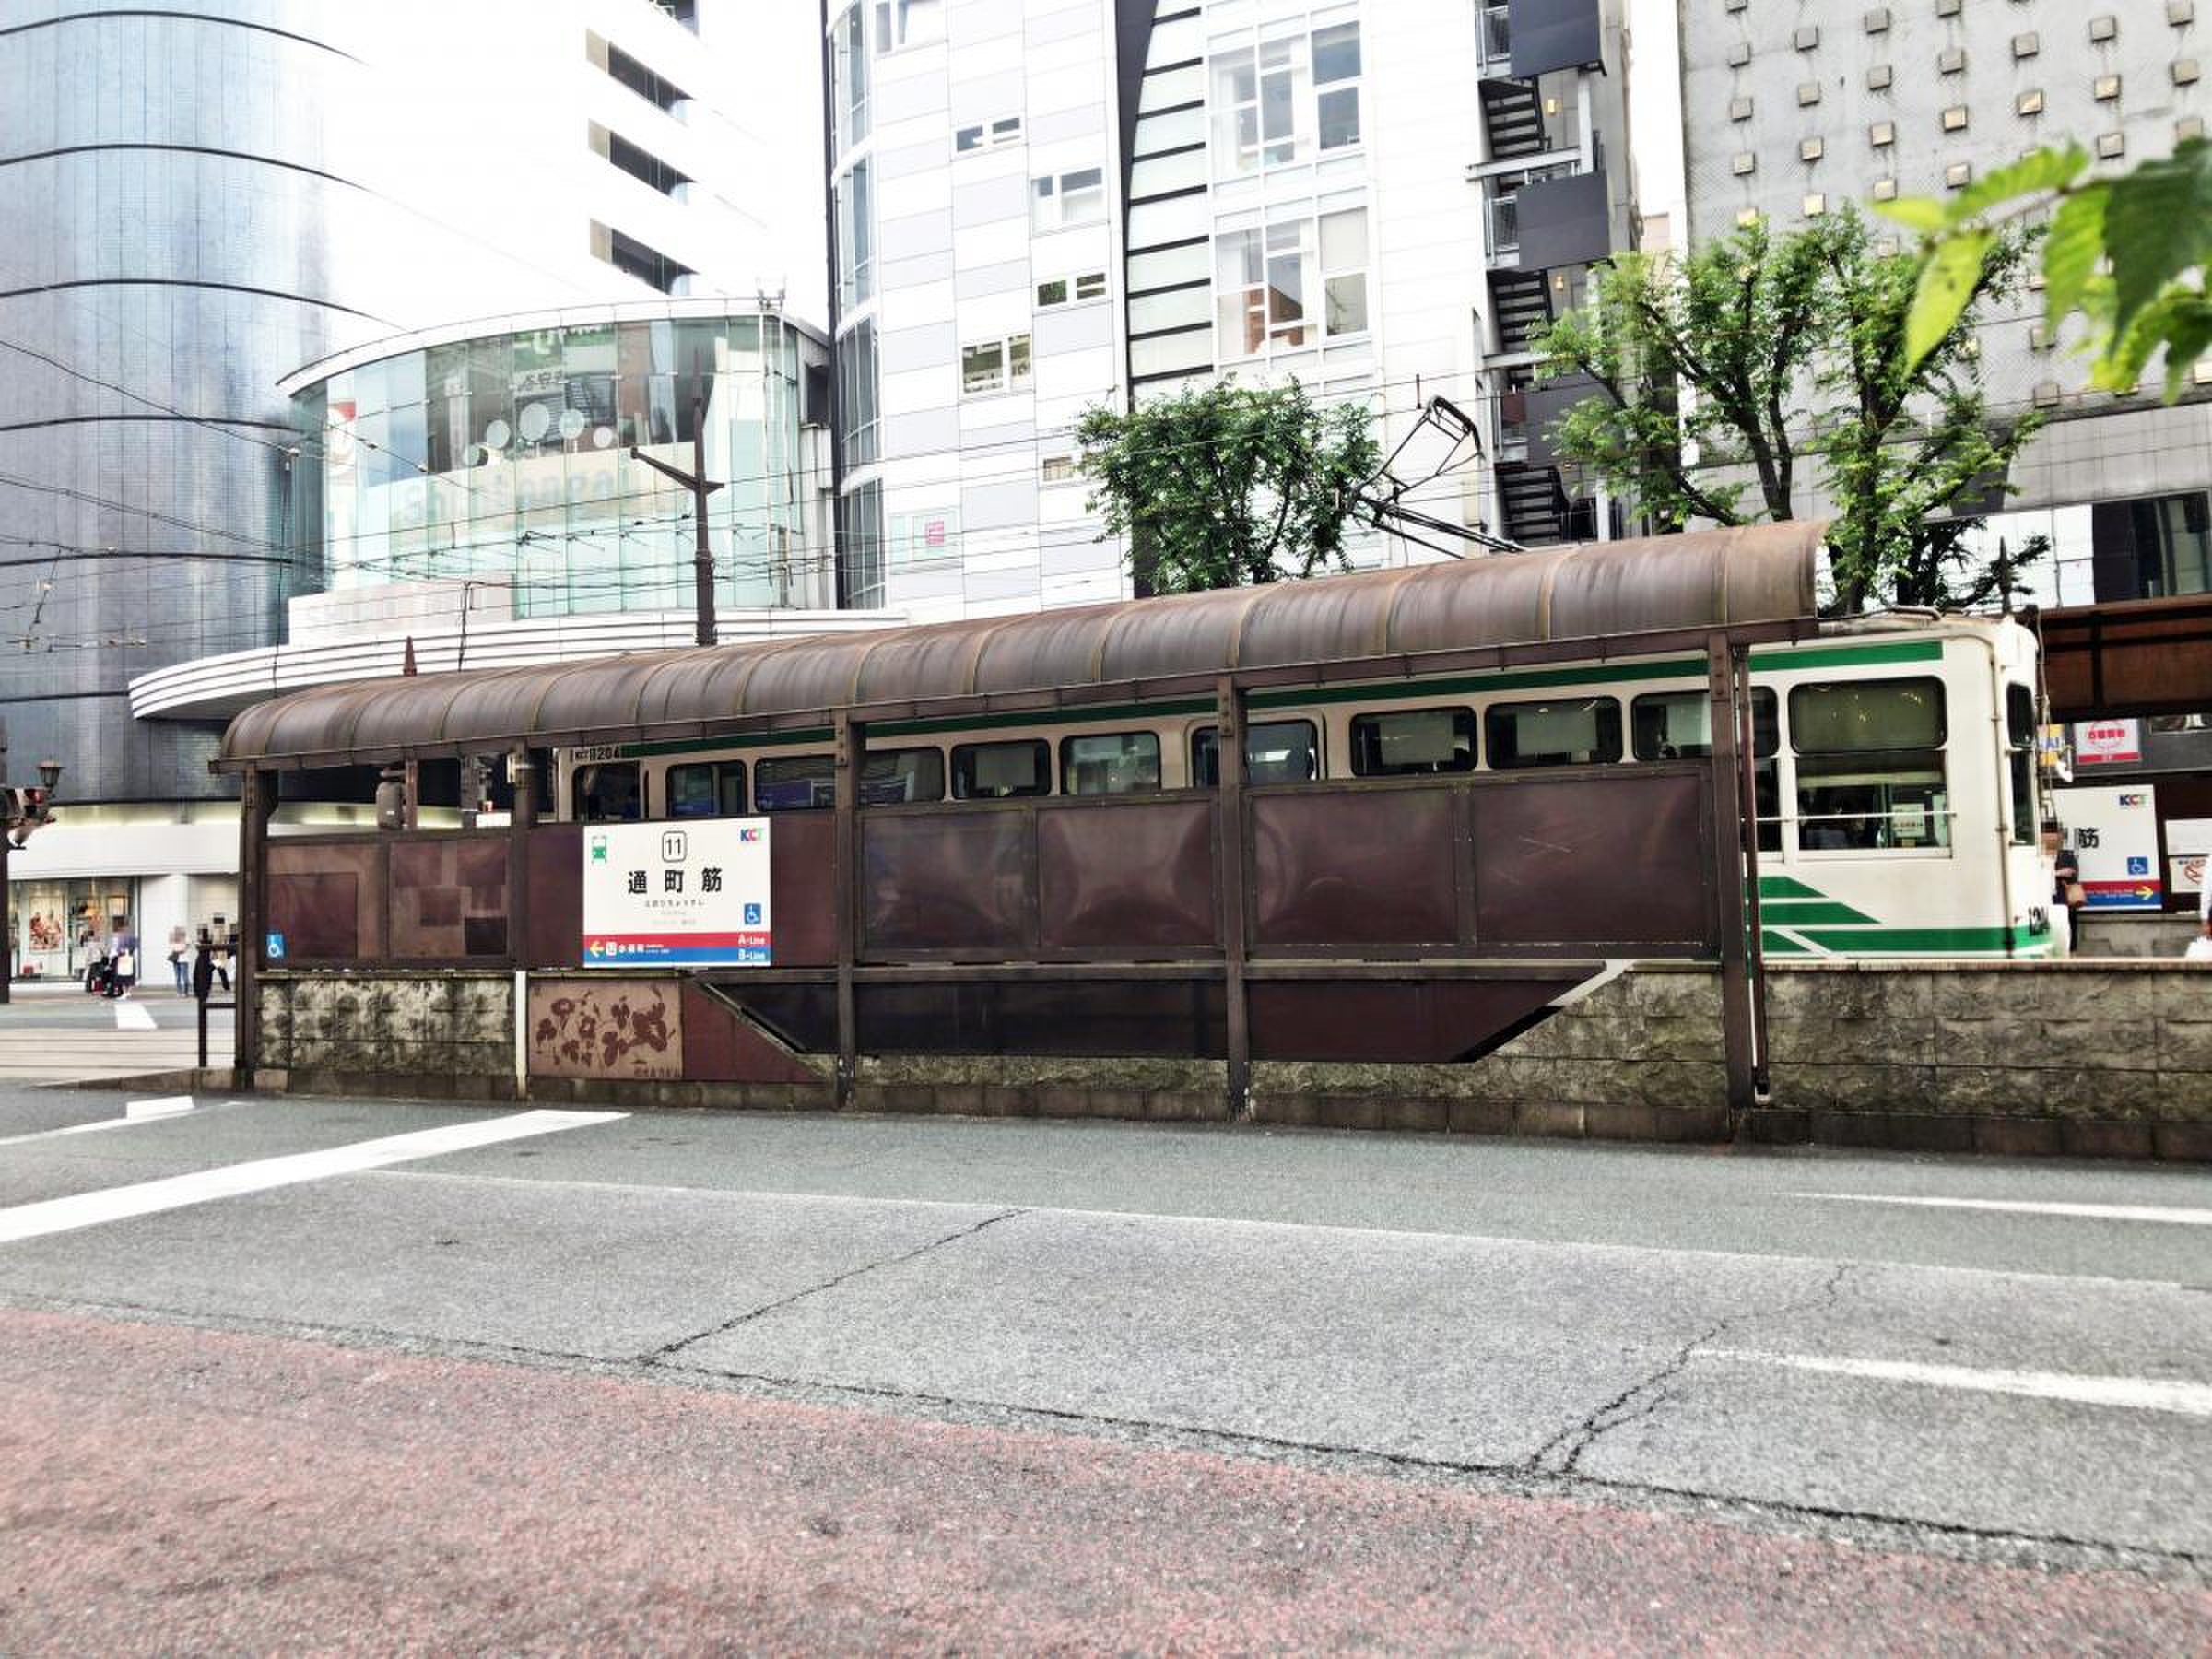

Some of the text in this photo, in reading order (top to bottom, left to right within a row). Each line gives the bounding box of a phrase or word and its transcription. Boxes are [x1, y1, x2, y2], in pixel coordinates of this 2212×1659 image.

[2119, 794, 2149, 807] KCT
[740, 828, 763, 841] KCT
[665, 838, 682, 856] 11
[628, 867, 723, 895] 通町筋
